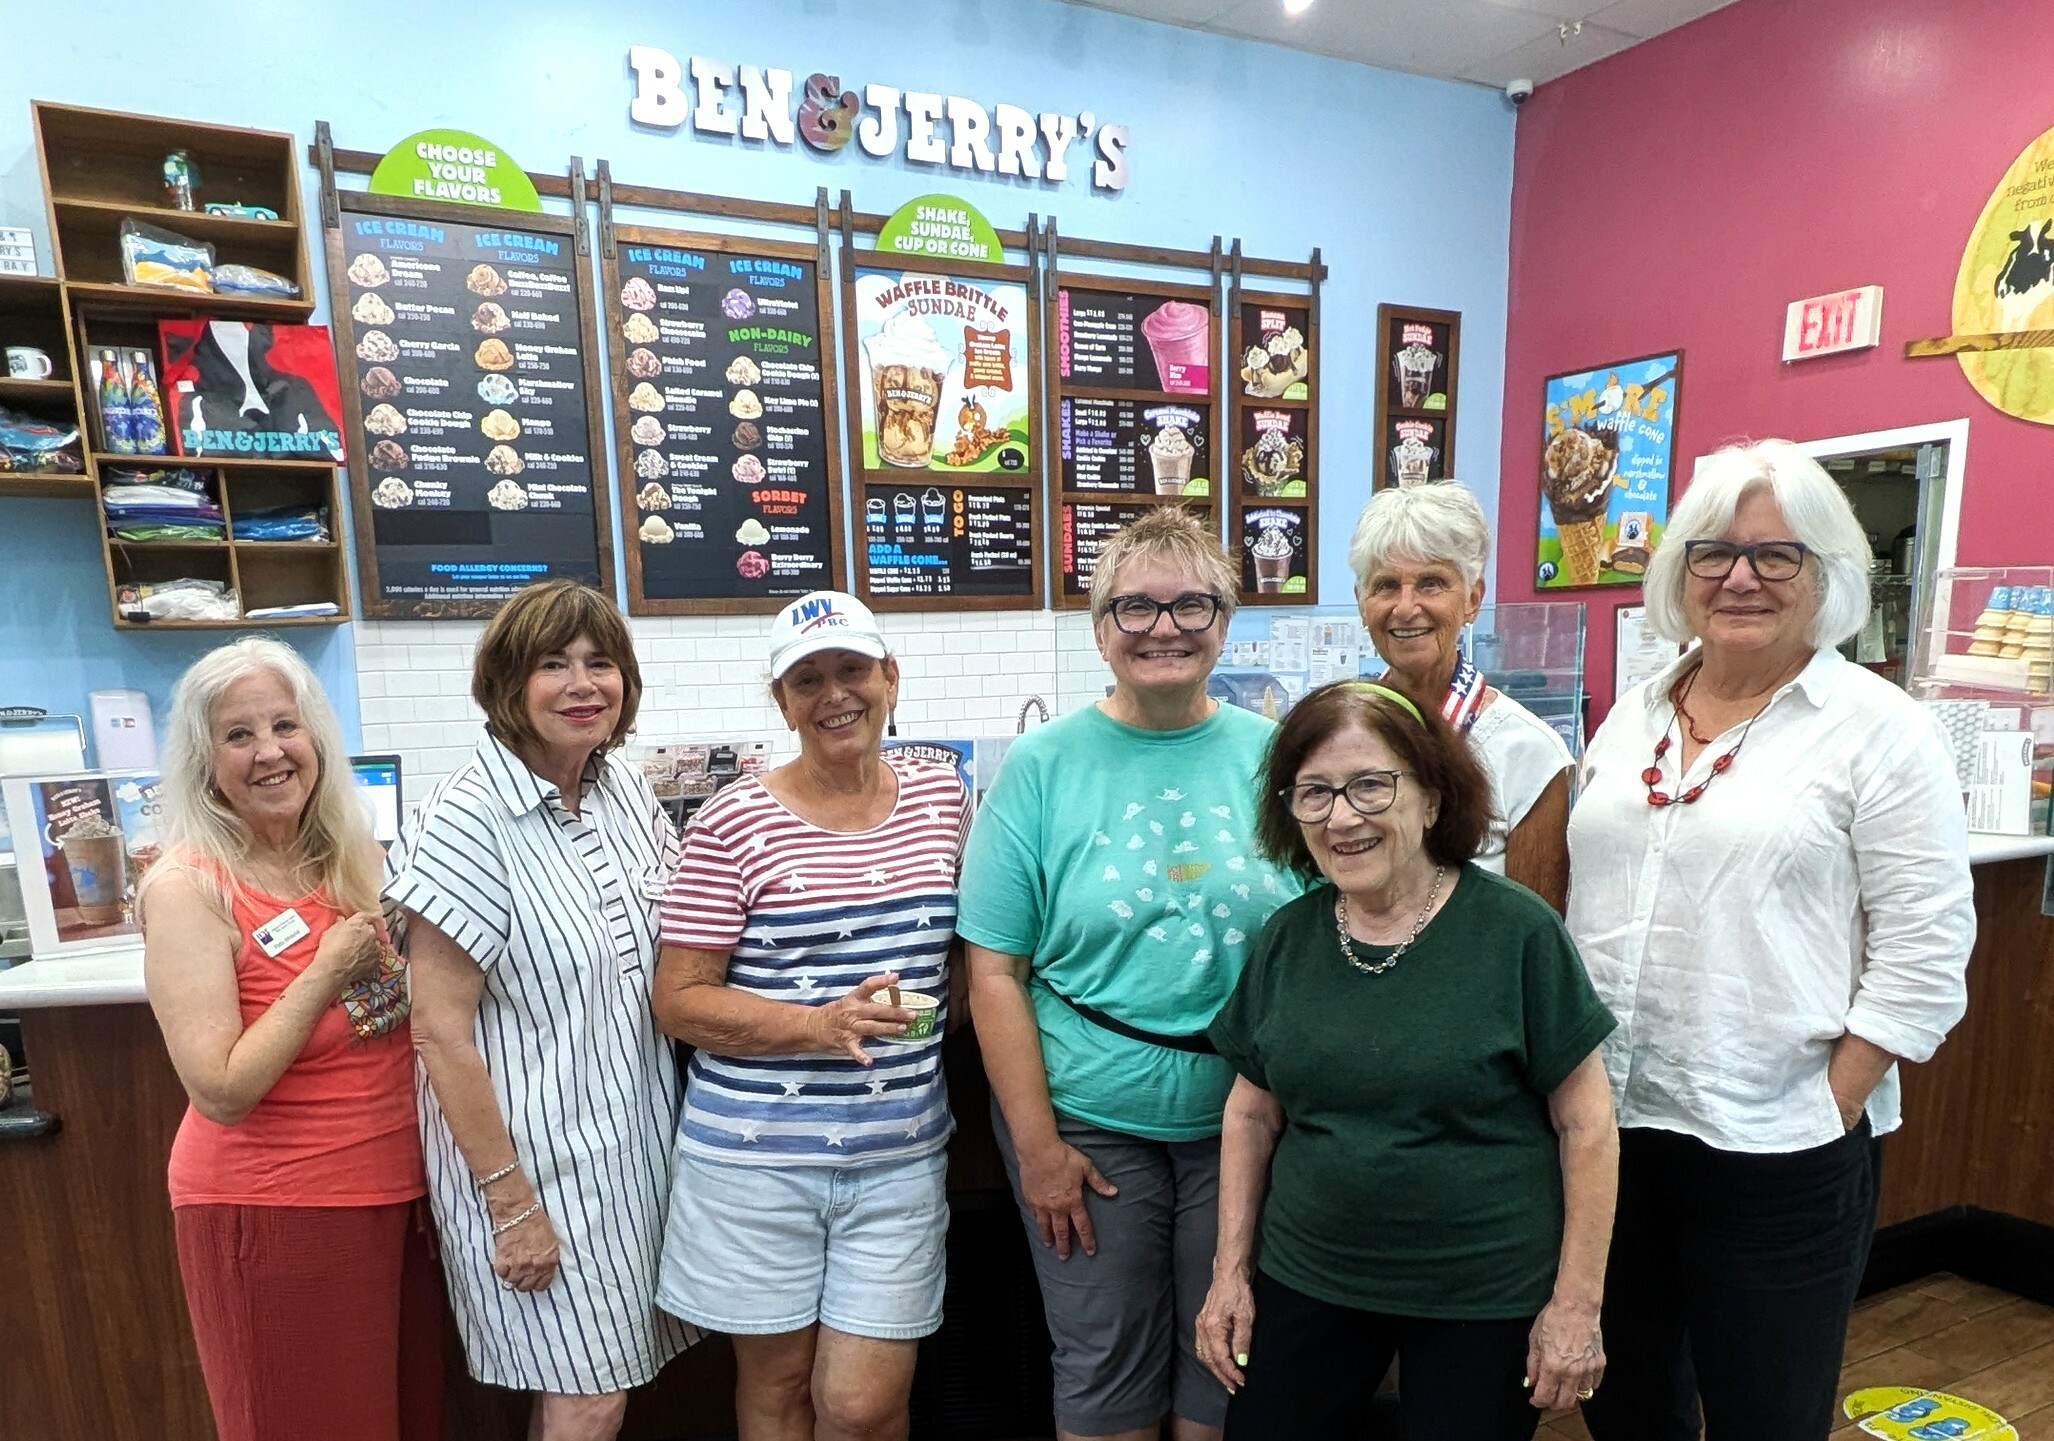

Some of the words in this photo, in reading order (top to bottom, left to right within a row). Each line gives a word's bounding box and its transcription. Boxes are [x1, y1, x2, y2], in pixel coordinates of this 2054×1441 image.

[629, 44, 795, 144] BEN
[799, 72, 859, 152] &
[858, 83, 1129, 190] JERRY'S
[416, 142, 497, 168] CHOOSE
[428, 162, 486, 185] YOUR
[413, 179, 502, 204] FLAVORS
[2014, 196, 2047, 212] from
[916, 205, 971, 227] SHAKE,
[355, 221, 383, 235] ICE
[385, 221, 445, 243] CREAM
[910, 221, 975, 243] SUNDAE,
[380, 238, 424, 251] FLAVORS
[475, 234, 500, 248] ICE
[503, 234, 559, 256] CREAM
[894, 236, 924, 251] CUP
[925, 239, 949, 255] OR
[949, 242, 989, 259] CONE
[498, 250, 539, 263] FLAVORS
[628, 249, 652, 262] ICE
[654, 249, 705, 270] CREAM
[648, 264, 687, 277] FLAVORS
[729, 259, 752, 274] ICE
[754, 260, 803, 280] CREAM
[749, 275, 786, 287] FLAVORS
[875, 280, 941, 309] WAFFLE
[945, 281, 1009, 322] BRITTLE
[907, 298, 977, 322] SUNDAE
[530, 312, 560, 323] Baked
[1798, 291, 1861, 352] EXIT
[728, 327, 812, 348] NON-DAIRY
[1058, 289, 1070, 377] SMOOTHIES
[399, 339, 430, 349] Cherry
[430, 341, 461, 351] Garcia
[515, 343, 543, 354] Honey
[544, 345, 578, 356] Graham
[753, 342, 789, 354] FLAVORS
[685, 358, 706, 368] Food
[1169, 364, 1187, 373] Berry
[403, 376, 449, 387] Chocolate
[518, 378, 575, 390] Marshmallow
[764, 396, 779, 405] Key
[406, 408, 452, 419] Chocolate
[452, 411, 473, 420] Chip
[1254, 411, 1273, 422] Waffle
[407, 417, 440, 427] Cookie
[440, 419, 472, 429] Dough
[521, 418, 552, 427] Mango
[1156, 415, 1189, 428] SHAKE
[1256, 420, 1289, 431] SUNDAE
[667, 423, 712, 434] Strawberry
[1061, 400, 1072, 460] SHAKES
[1597, 411, 1636, 432] waffle
[1638, 423, 1665, 445] cone
[183, 429, 235, 450] BEN
[234, 431, 254, 451] &
[253, 429, 340, 452] JERRY'S
[410, 445, 457, 454] Chocolate
[442, 455, 481, 464] Brownie
[551, 454, 584, 463] Cookies
[767, 458, 810, 468] Strawberry
[1631, 454, 1655, 466] dipped
[1655, 454, 1663, 464] in
[677, 462, 708, 470] Cookies
[1622, 470, 1666, 480] marshmallow
[547, 485, 587, 493] Chocolate
[1637, 478, 1648, 491] &
[415, 489, 451, 498] Monkey
[688, 487, 717, 496] Tonight
[751, 490, 807, 504] SORBET
[1624, 490, 1657, 501] chocolate
[953, 490, 964, 514] GO
[673, 522, 702, 531] Vanilla
[954, 515, 965, 537] TO
[1259, 518, 1288, 528] SHAKE
[771, 526, 810, 534] Lemonade
[1062, 504, 1073, 573] SUNDAES
[869, 544, 892, 553] ADD
[893, 544, 902, 554] A
[770, 553, 793, 561] Berry
[793, 554, 815, 562] Berry
[869, 555, 910, 565] WAFFLE
[431, 564, 458, 572] FOOD
[458, 564, 498, 573] ALLERGY
[499, 563, 550, 573] CONCERNS?
[771, 561, 823, 569] Extraordinary
[792, 598, 832, 626] LWV
[903, 746, 913, 759] &
[914, 746, 959, 766] JERRY'S
[47, 809, 72, 821] Honey
[71, 799, 101, 812] Graham
[58, 816, 77, 827] Latte
[78, 808, 101, 819] Shake
